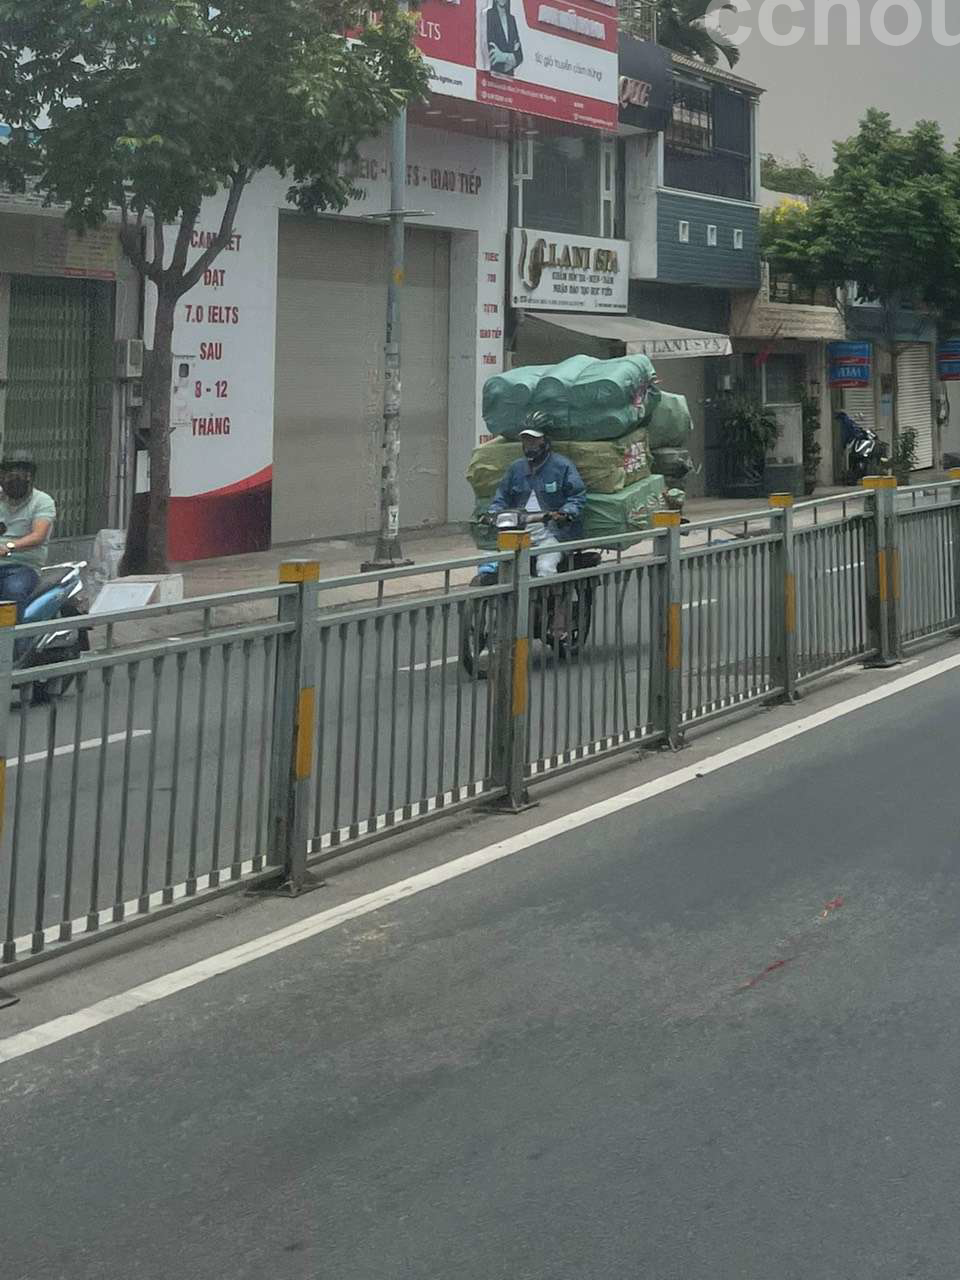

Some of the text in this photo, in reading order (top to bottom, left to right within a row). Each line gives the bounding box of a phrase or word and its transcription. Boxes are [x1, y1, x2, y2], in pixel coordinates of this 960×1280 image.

[418, 19, 441, 41] LTS
[185, 304, 239, 324] 7.0 IELTS
[199, 342, 222, 361] SAU
[215, 381, 228, 398] 12
